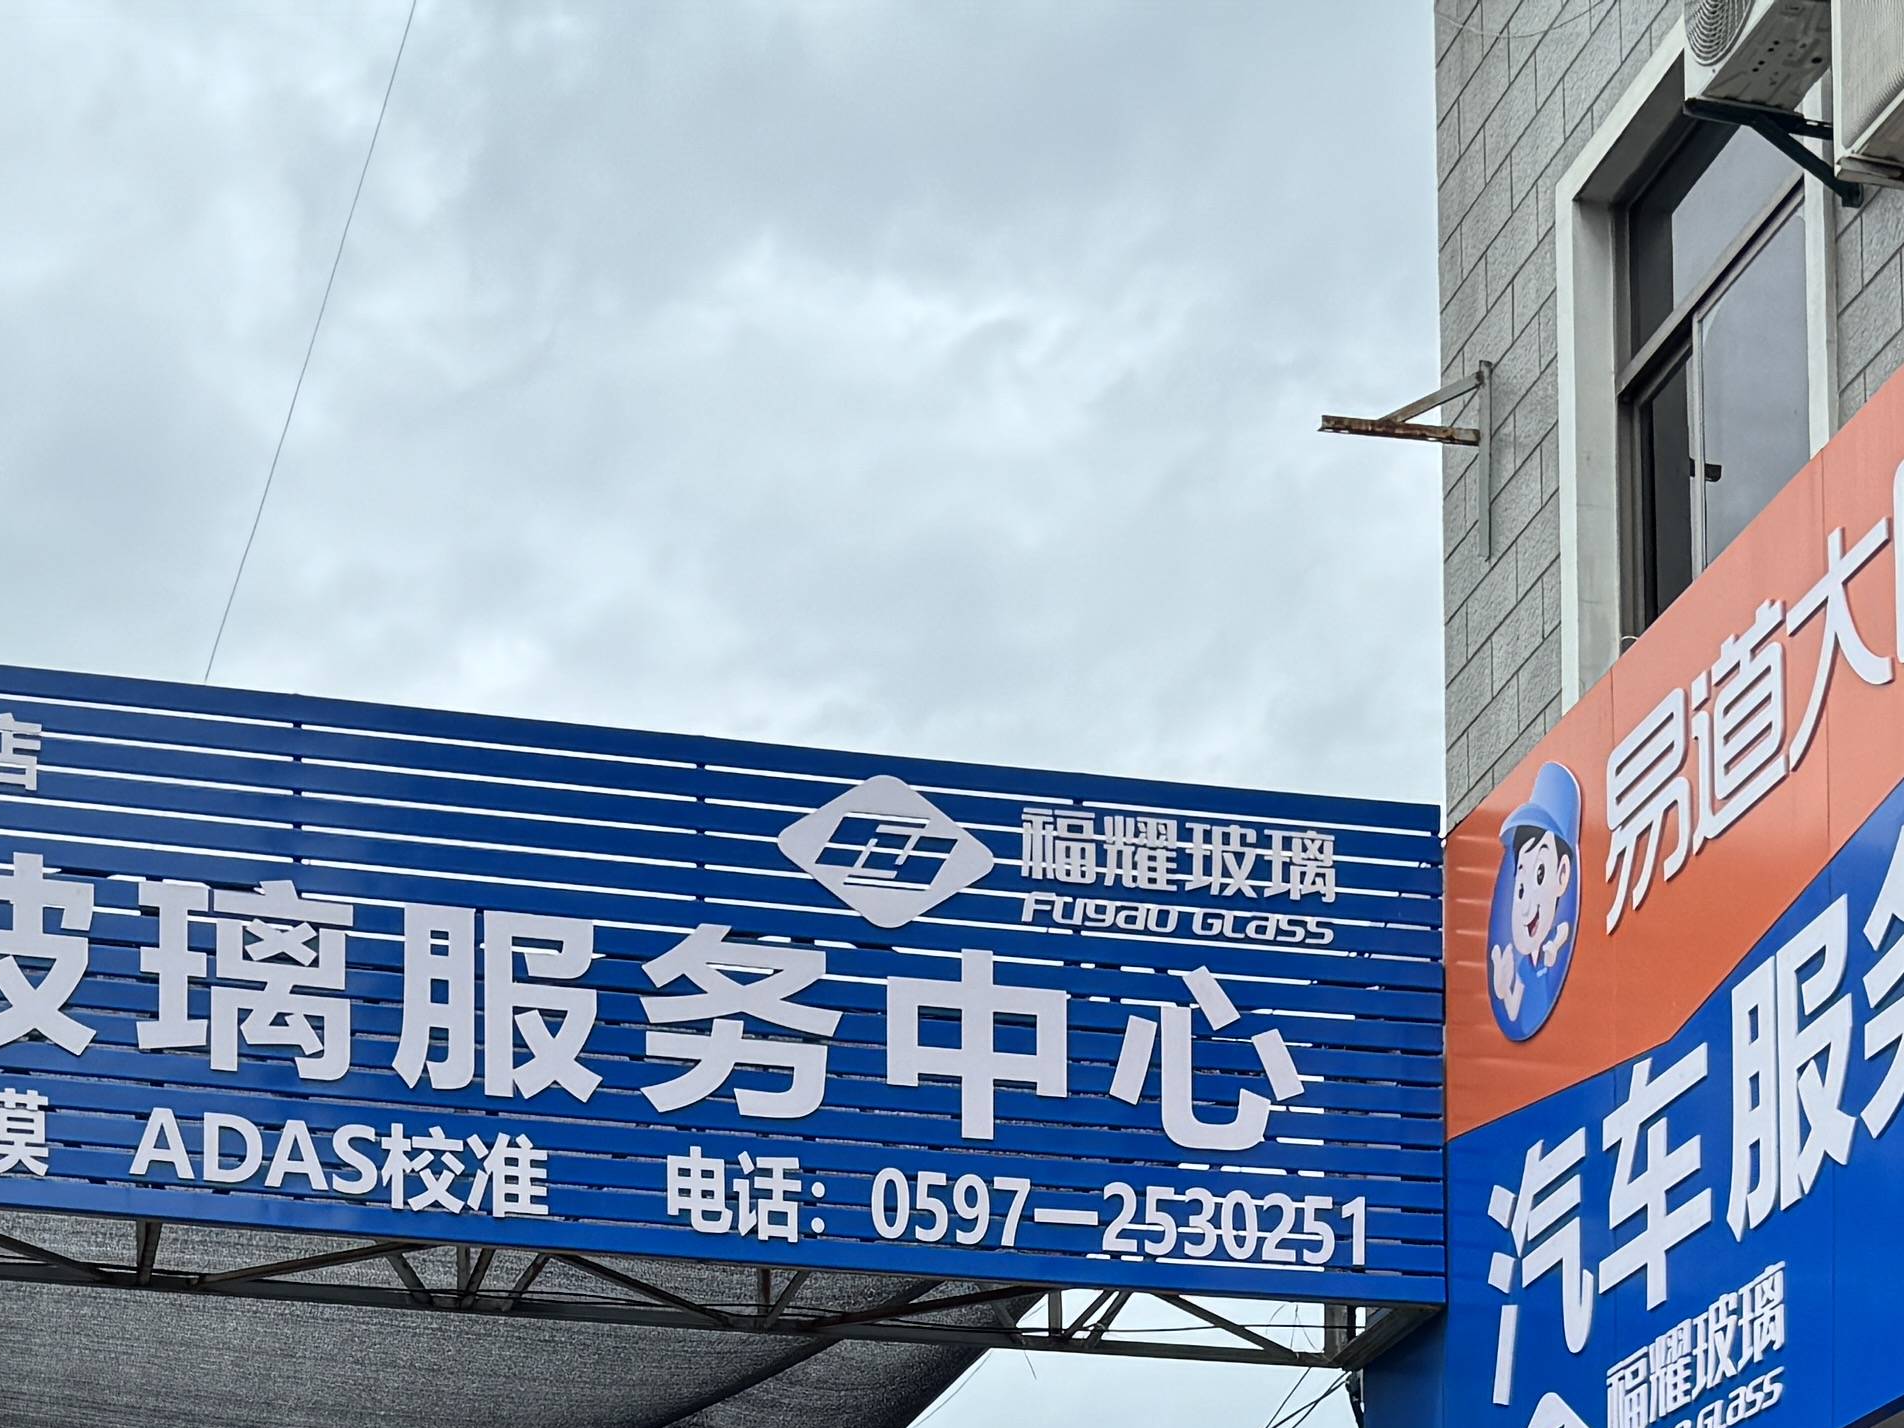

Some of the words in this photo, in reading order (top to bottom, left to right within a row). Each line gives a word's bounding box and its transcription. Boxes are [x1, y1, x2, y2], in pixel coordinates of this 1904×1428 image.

[1020, 805, 1337, 905] 福耀玻璃
[129, 1106, 550, 1219] ADAS校准
